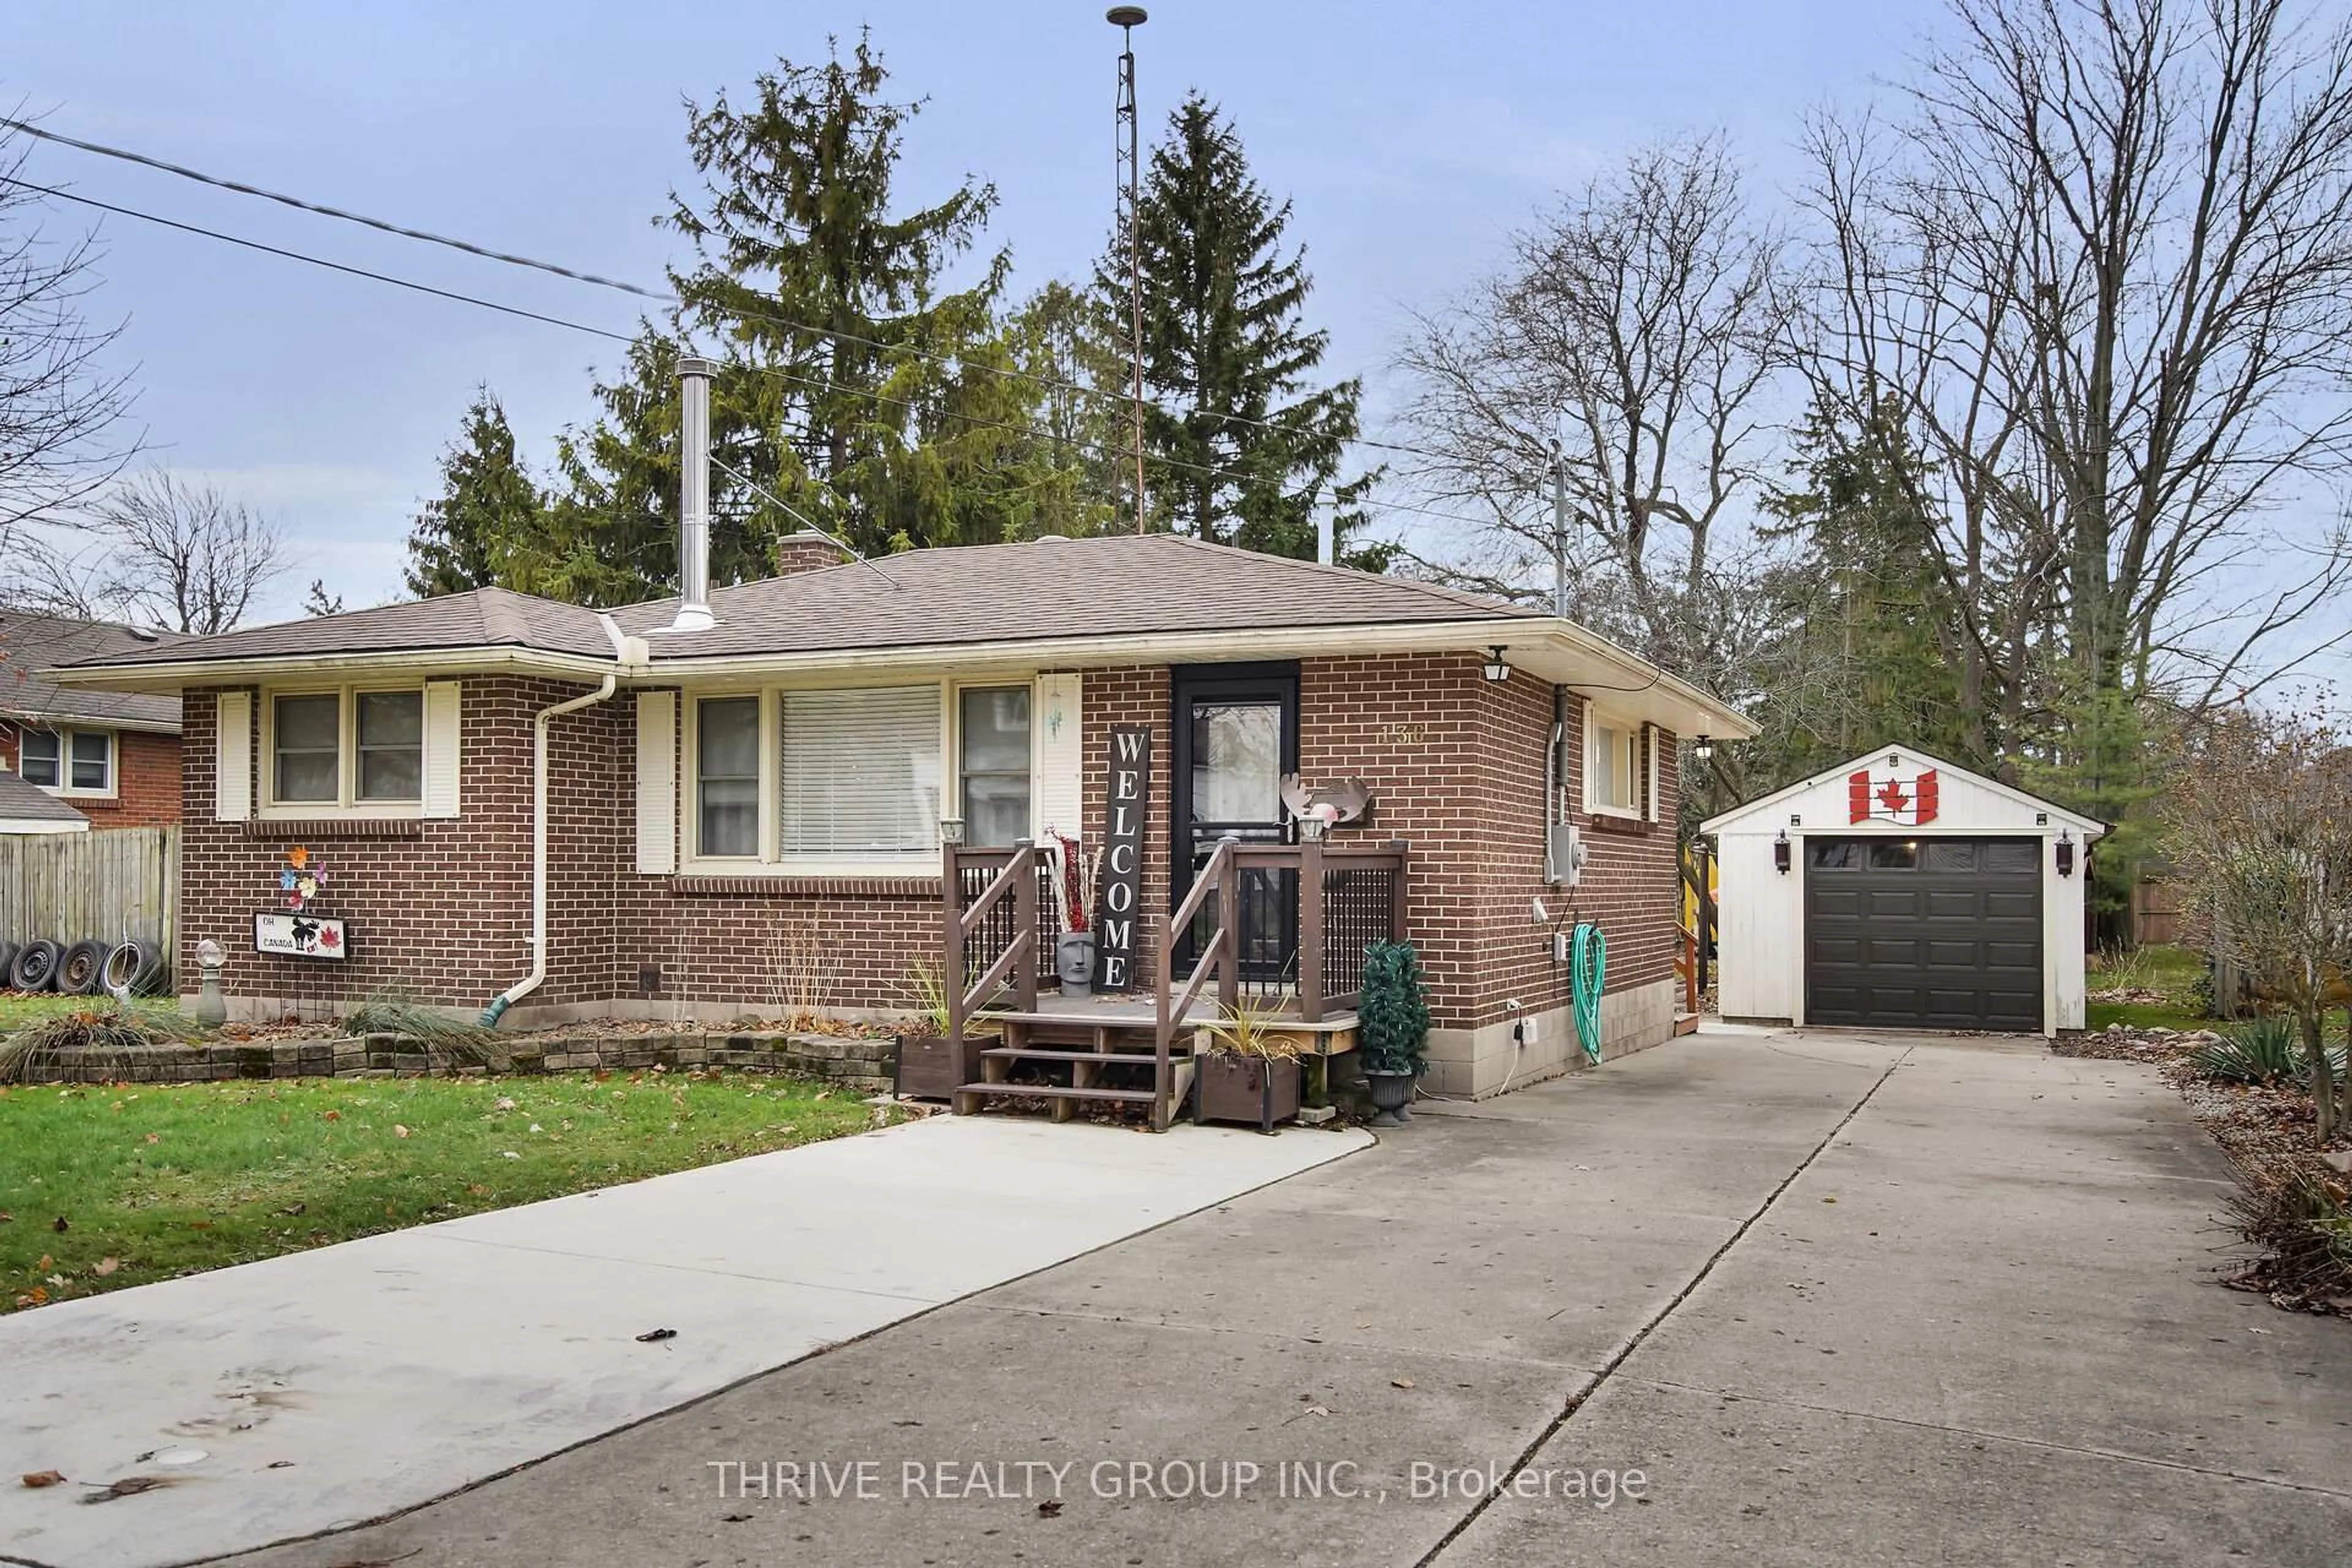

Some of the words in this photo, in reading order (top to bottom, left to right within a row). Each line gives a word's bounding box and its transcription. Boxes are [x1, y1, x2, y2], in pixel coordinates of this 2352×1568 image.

[1382, 725, 1423, 743] 136
[1104, 734, 1145, 986] WELCOME
[263, 917, 274, 925] OH
[263, 938, 293, 948] CANADA
